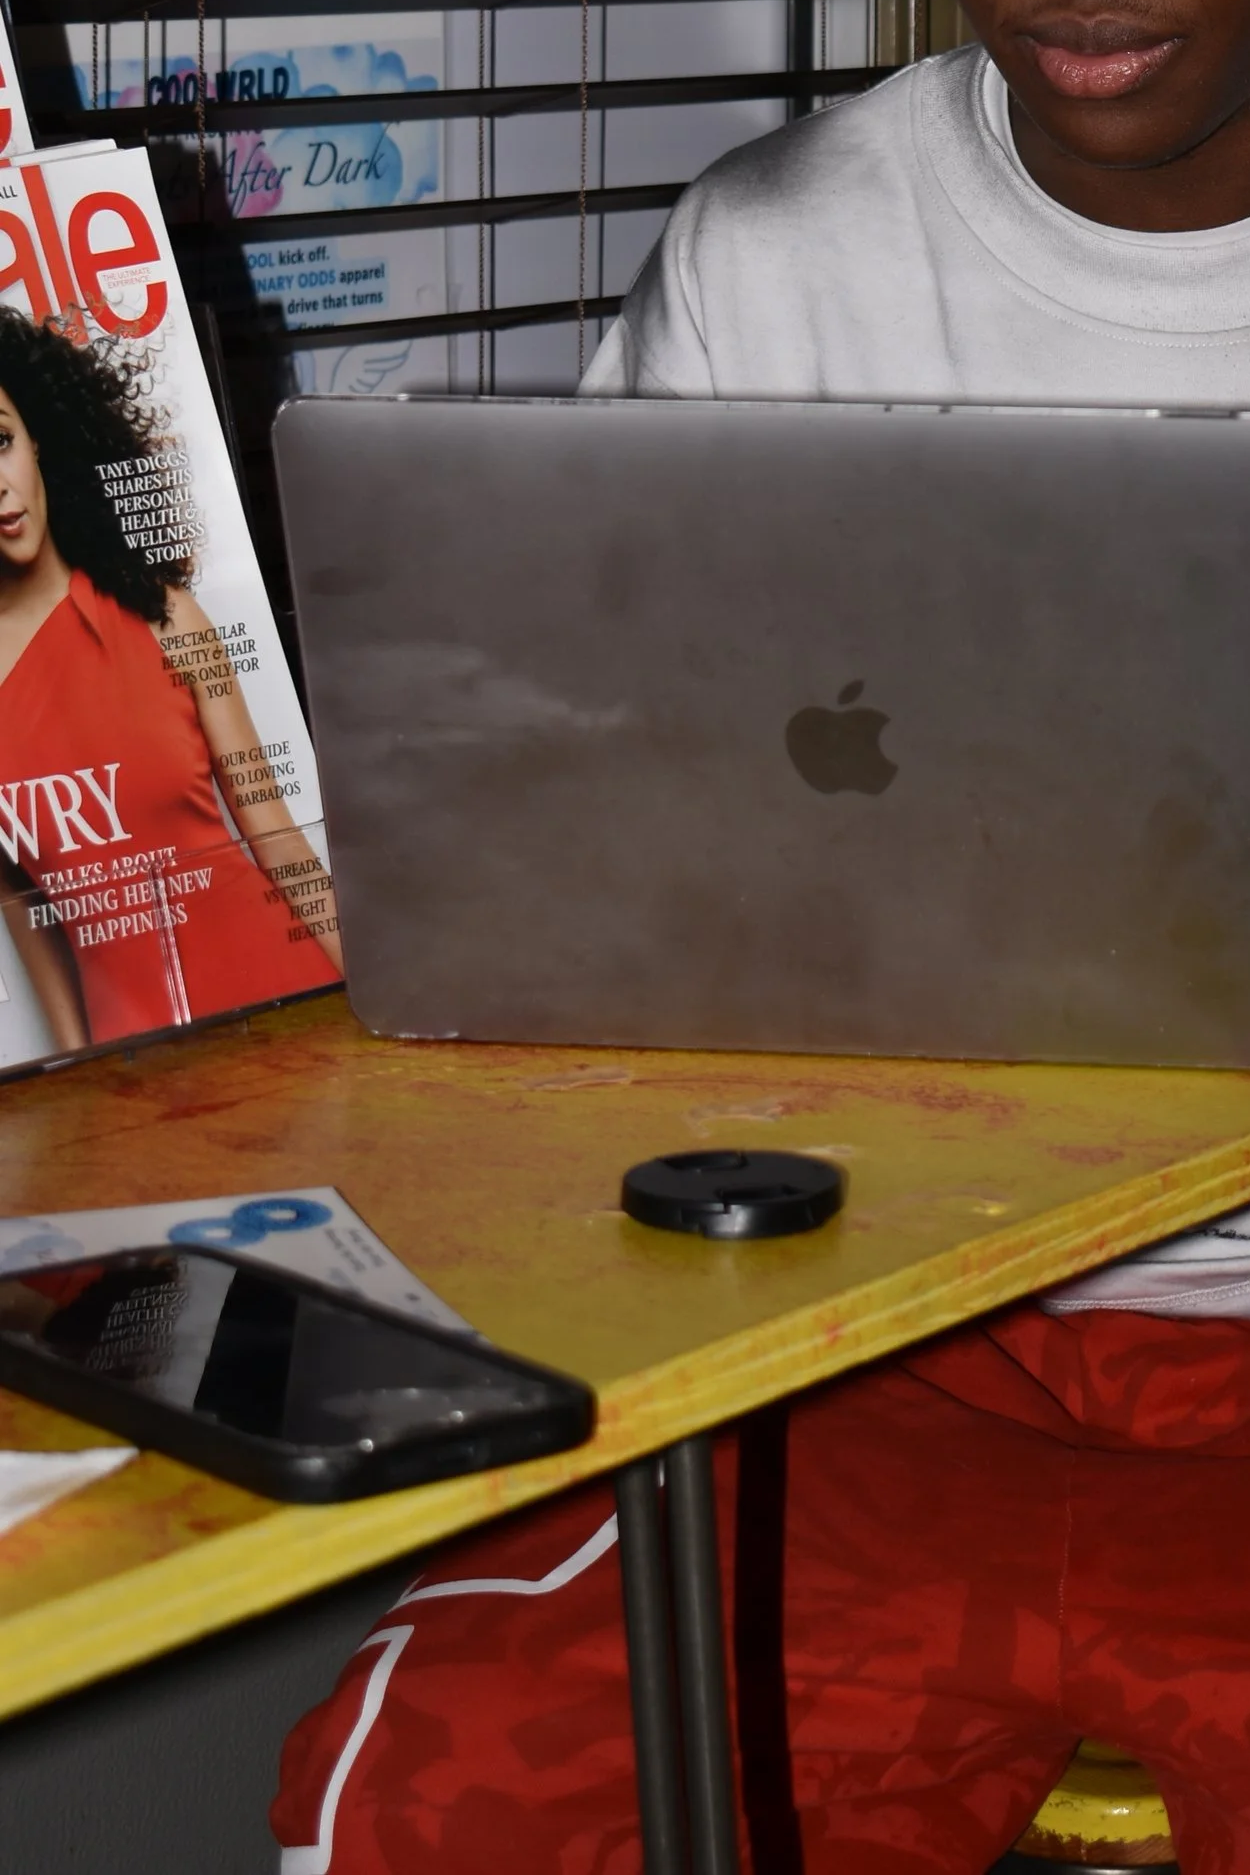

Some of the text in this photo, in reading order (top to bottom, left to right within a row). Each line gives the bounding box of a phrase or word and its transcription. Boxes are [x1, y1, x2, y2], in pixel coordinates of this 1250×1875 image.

[219, 141, 293, 218] After
[303, 121, 400, 187] Dark
[278, 249, 304, 267] kick
[308, 245, 331, 263] off.
[297, 270, 337, 289] ODDS
[339, 263, 386, 285] apparel
[287, 290, 384, 315] drive that turns
[95, 450, 188, 480] TAYE DIGGS
[104, 468, 193, 498] SHARES HIS
[114, 487, 195, 515] PERSONAL
[121, 502, 198, 532] HEALTH &
[125, 520, 205, 549] WELLNESS
[145, 541, 194, 565] STORY
[159, 622, 247, 652] SPECTACULAR
[162, 639, 257, 671] BEAUTY & HAIR
[169, 657, 260, 688] TIPS ONLY FOR
[206, 681, 233, 699] YOU
[219, 741, 291, 769] OUR GUIDE
[228, 761, 295, 788] TO LOVING
[236, 781, 301, 809] BARBADOS
[265, 857, 322, 882] THREADS
[28, 888, 119, 930] FINDING
[169, 867, 213, 897] NEW
[264, 889, 280, 904] VS
[290, 898, 327, 921] FIGHT
[288, 920, 325, 943] HEATS
